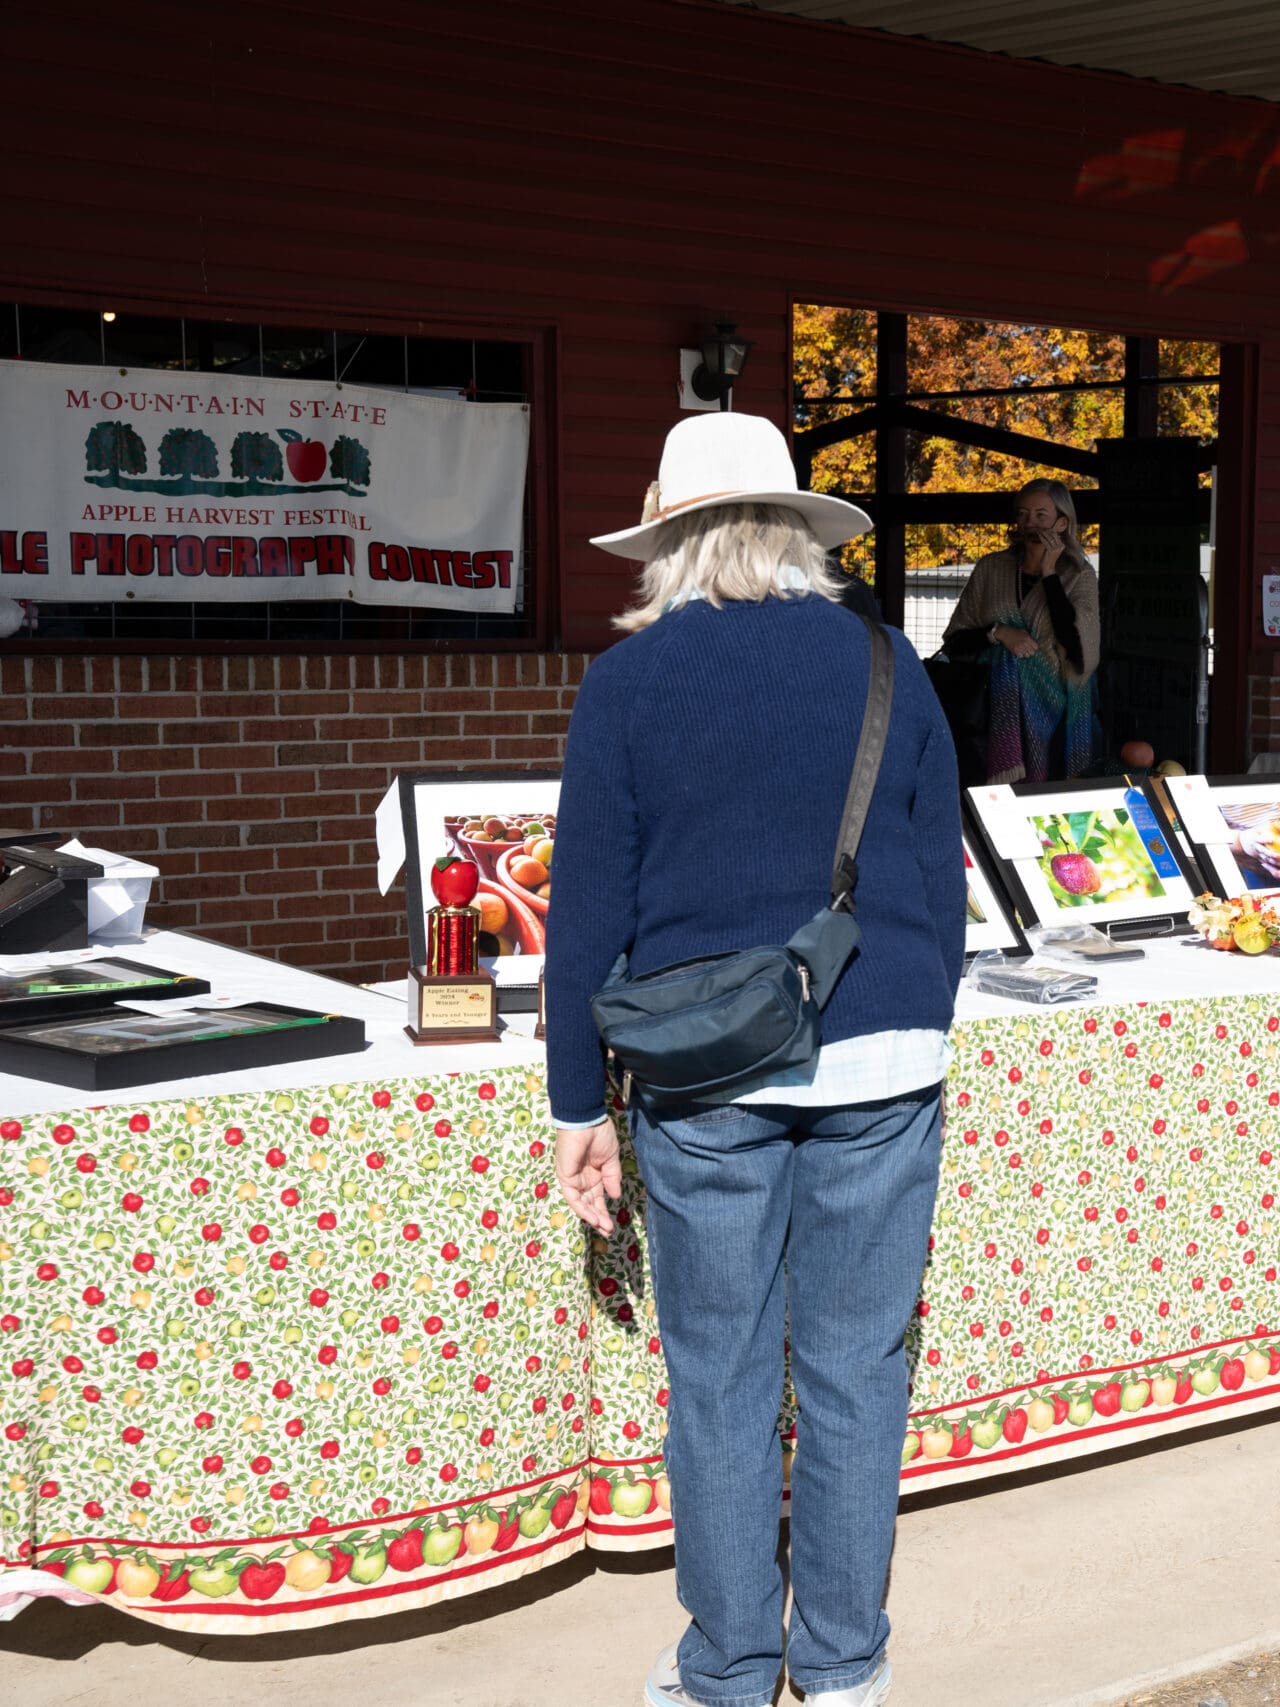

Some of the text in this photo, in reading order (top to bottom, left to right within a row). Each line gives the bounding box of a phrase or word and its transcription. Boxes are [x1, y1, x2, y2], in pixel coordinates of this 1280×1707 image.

[82, 504, 157, 523] APPLE
[165, 507, 275, 526] HARVEST
[0, 530, 49, 575] LE
[367, 541, 513, 589] CONTEST
